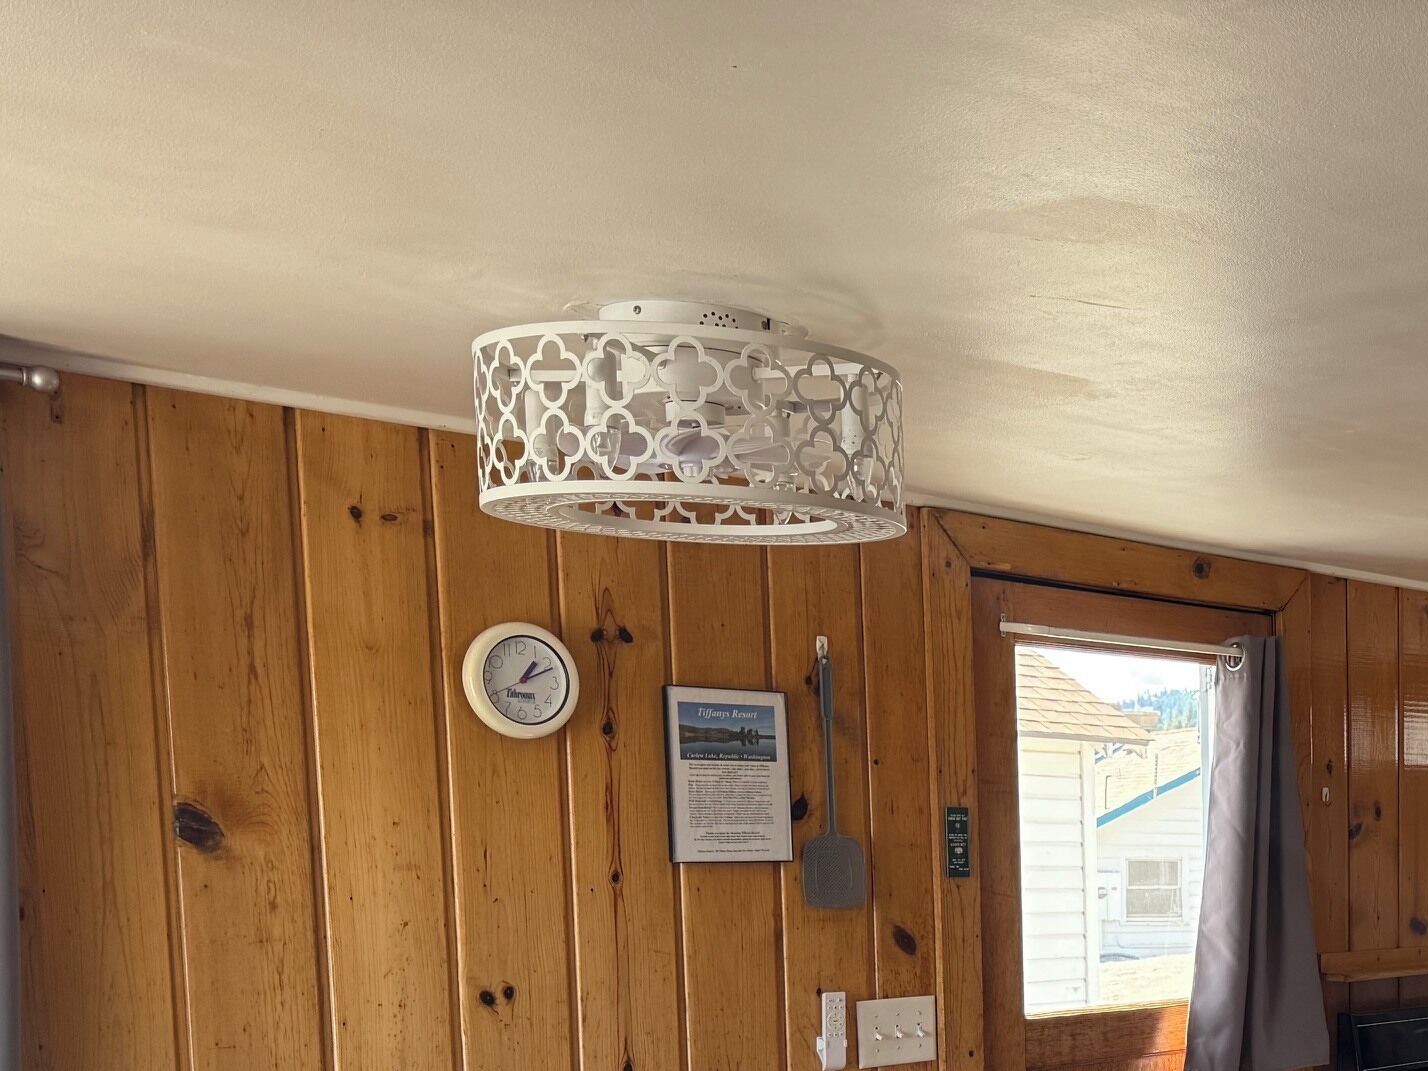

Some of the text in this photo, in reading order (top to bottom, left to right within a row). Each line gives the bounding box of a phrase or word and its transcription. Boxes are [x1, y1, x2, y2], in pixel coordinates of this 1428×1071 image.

[503, 642, 511, 657] 11
[515, 640, 527, 656] 12
[488, 654, 504, 670] 10
[542, 656, 552, 670] 2
[486, 670, 493, 685] 9
[550, 676, 559, 691] 3
[502, 701, 512, 715] 7
[544, 694, 553, 708] 4
[517, 706, 527, 720] 6
[533, 704, 543, 718] 5
[697, 707, 758, 720] Tiffanys Resort
